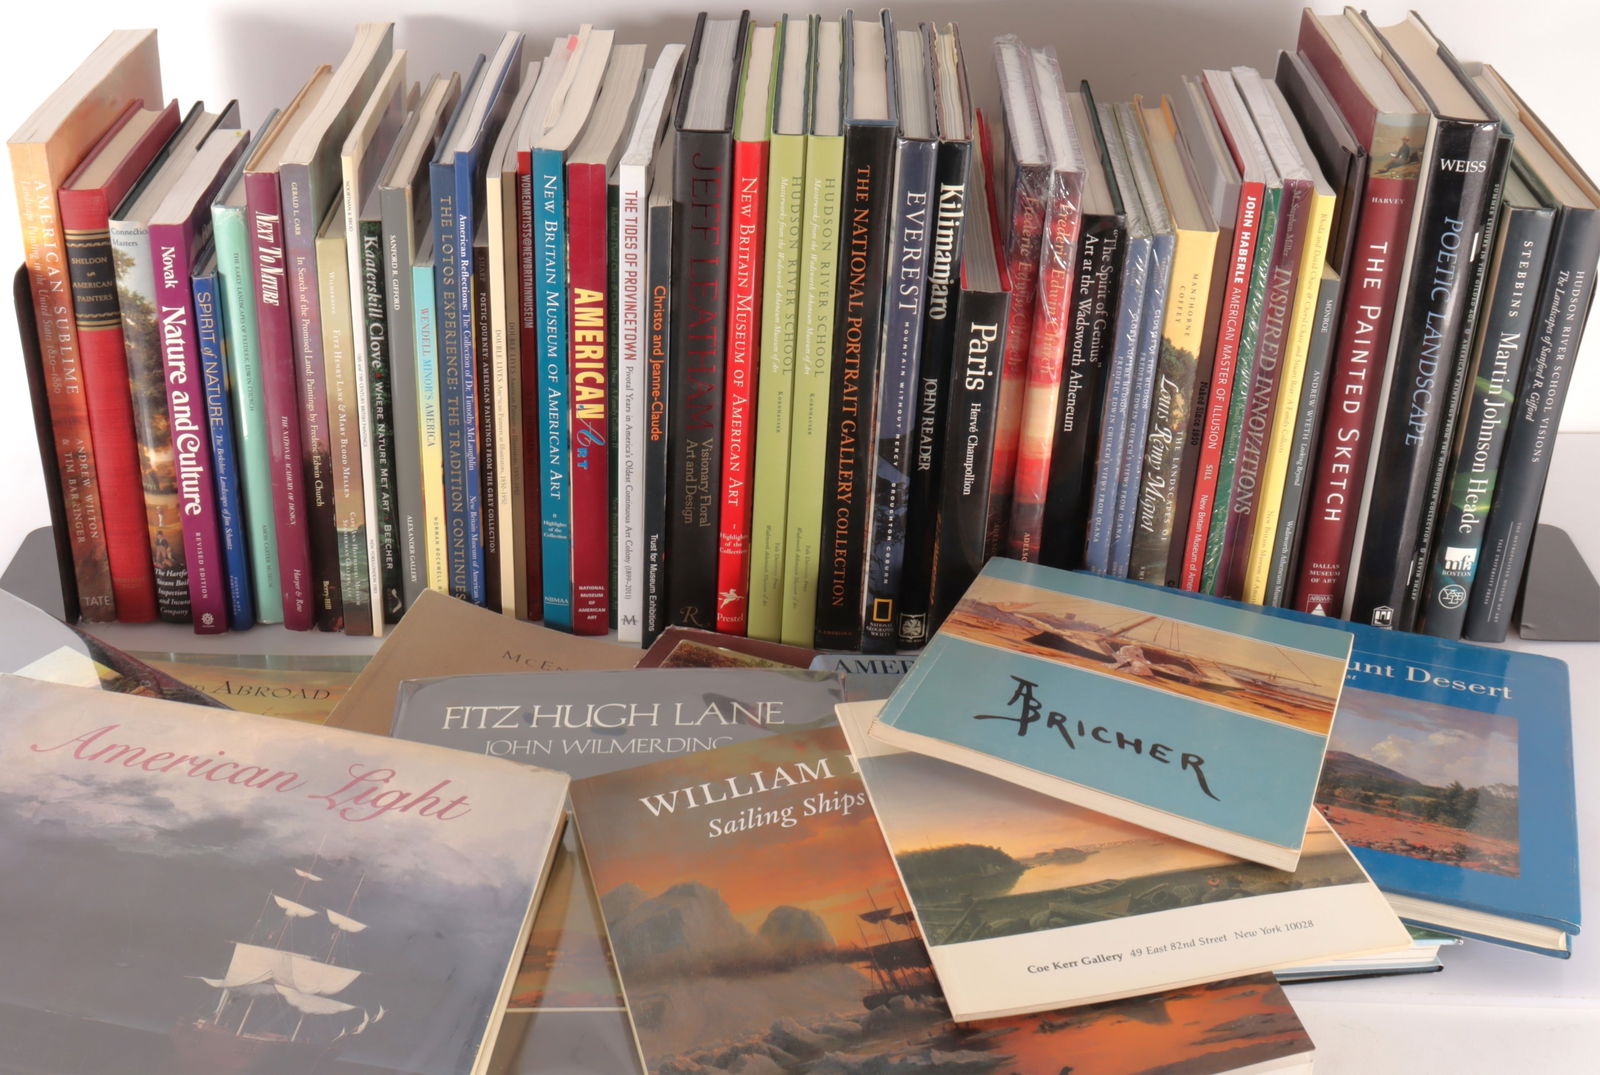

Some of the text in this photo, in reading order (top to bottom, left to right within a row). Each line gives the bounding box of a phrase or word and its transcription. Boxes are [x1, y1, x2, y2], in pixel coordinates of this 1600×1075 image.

[855, 165, 871, 202] THE
[1440, 158, 1488, 172] WEISS
[34, 181, 79, 394] AMERICAN SUBLIME
[256, 211, 285, 306] NEXT NATURE
[480, 292, 488, 321] POETIC
[686, 152, 722, 431] JEFF LEATHAM
[782, 175, 802, 376] HUDSON RIVER SCHOOL
[814, 178, 836, 378] HUDSON RIVER SCHOOL
[847, 208, 870, 312] NATIONAL
[1095, 265, 1113, 299] Spirit
[1175, 285, 1185, 324] COFFEY
[1184, 273, 1199, 338] MANTHORNE
[197, 292, 224, 430] SPIRIT NATURE:
[440, 196, 463, 513] THE LOTOS EXPERIENCE: THE TRADITION
[459, 214, 476, 471] American Reflections: The Collection Timothy McLaughlin
[481, 322, 489, 360] JOURNEY:
[544, 174, 563, 500] NEW BRITAIN MUSEUM OF AMERICAN ART
[573, 287, 604, 420] AMERICAN
[649, 285, 665, 440] Christo and Jeanne-Claude
[728, 176, 758, 507] NEW BRITAIN MUSEUM AMERICAN ART
[841, 316, 864, 416] PORTRAIT
[887, 190, 927, 541] EVEREST WITHOUT MERCY BROUGHTON
[917, 182, 965, 472] Kilimanjaro JOHN READER
[1064, 298, 1092, 432] Wadsworth Atheneum
[1200, 195, 1257, 511] JOHN HABERLE AMERICAN MASTER ILLUSION New
[1259, 265, 1292, 371] INSPIRED
[1405, 216, 1464, 447] POETIC LANDSCAPE
[1531, 271, 1585, 463] HUDSON RIVER SCHOOL VISIONS
[1534, 288, 1565, 379] Landscapes Sanford
[161, 246, 208, 599] Novak Nature and Culture REVISED EDITION
[297, 268, 325, 507] Search Promised Frederic Edwin Church
[364, 236, 394, 569] Kaaterskill Clove NATURE MET ART BEECHER
[390, 235, 417, 584] SANFORD GIFFORD ALEXANDER GALLERY
[420, 307, 435, 447] WENDELL AMERICA
[484, 405, 492, 447] PAINTINGS
[623, 190, 638, 563] THE TIDES PROVINCETOWN Pivotal Years Continuous Colony
[962, 321, 998, 495] Paris Champollion
[1323, 241, 1388, 522] THE PAINTED SKETCH
[1458, 240, 1534, 534] STEBBINS Martin Johnson Heade
[698, 437, 714, 492] Visionary
[837, 419, 857, 504] GALLERY
[1100, 397, 1119, 492] EDWIN VIEWS
[1123, 393, 1141, 487] EDWIN VIEWS
[1164, 431, 1184, 524] THE LANDSCAPES
[1233, 375, 1273, 515] INNOVATIONS
[488, 509, 496, 553] COLLECTION
[648, 534, 658, 632] Trust Museum Exhibitions
[831, 508, 850, 607] COLLECTION
[212, 680, 331, 701] ABROAD
[441, 701, 785, 730] FITZ HUGH LANE
[1406, 666, 1513, 700] Desert
[30, 724, 472, 822] American Light
[484, 738, 552, 756] JOHN
[638, 757, 837, 818] WILLIAM
[708, 789, 866, 838] Sailing Ships
[1027, 920, 1315, 975] Coe Kerr Gallery 49 East 82nd Street New York 10028
